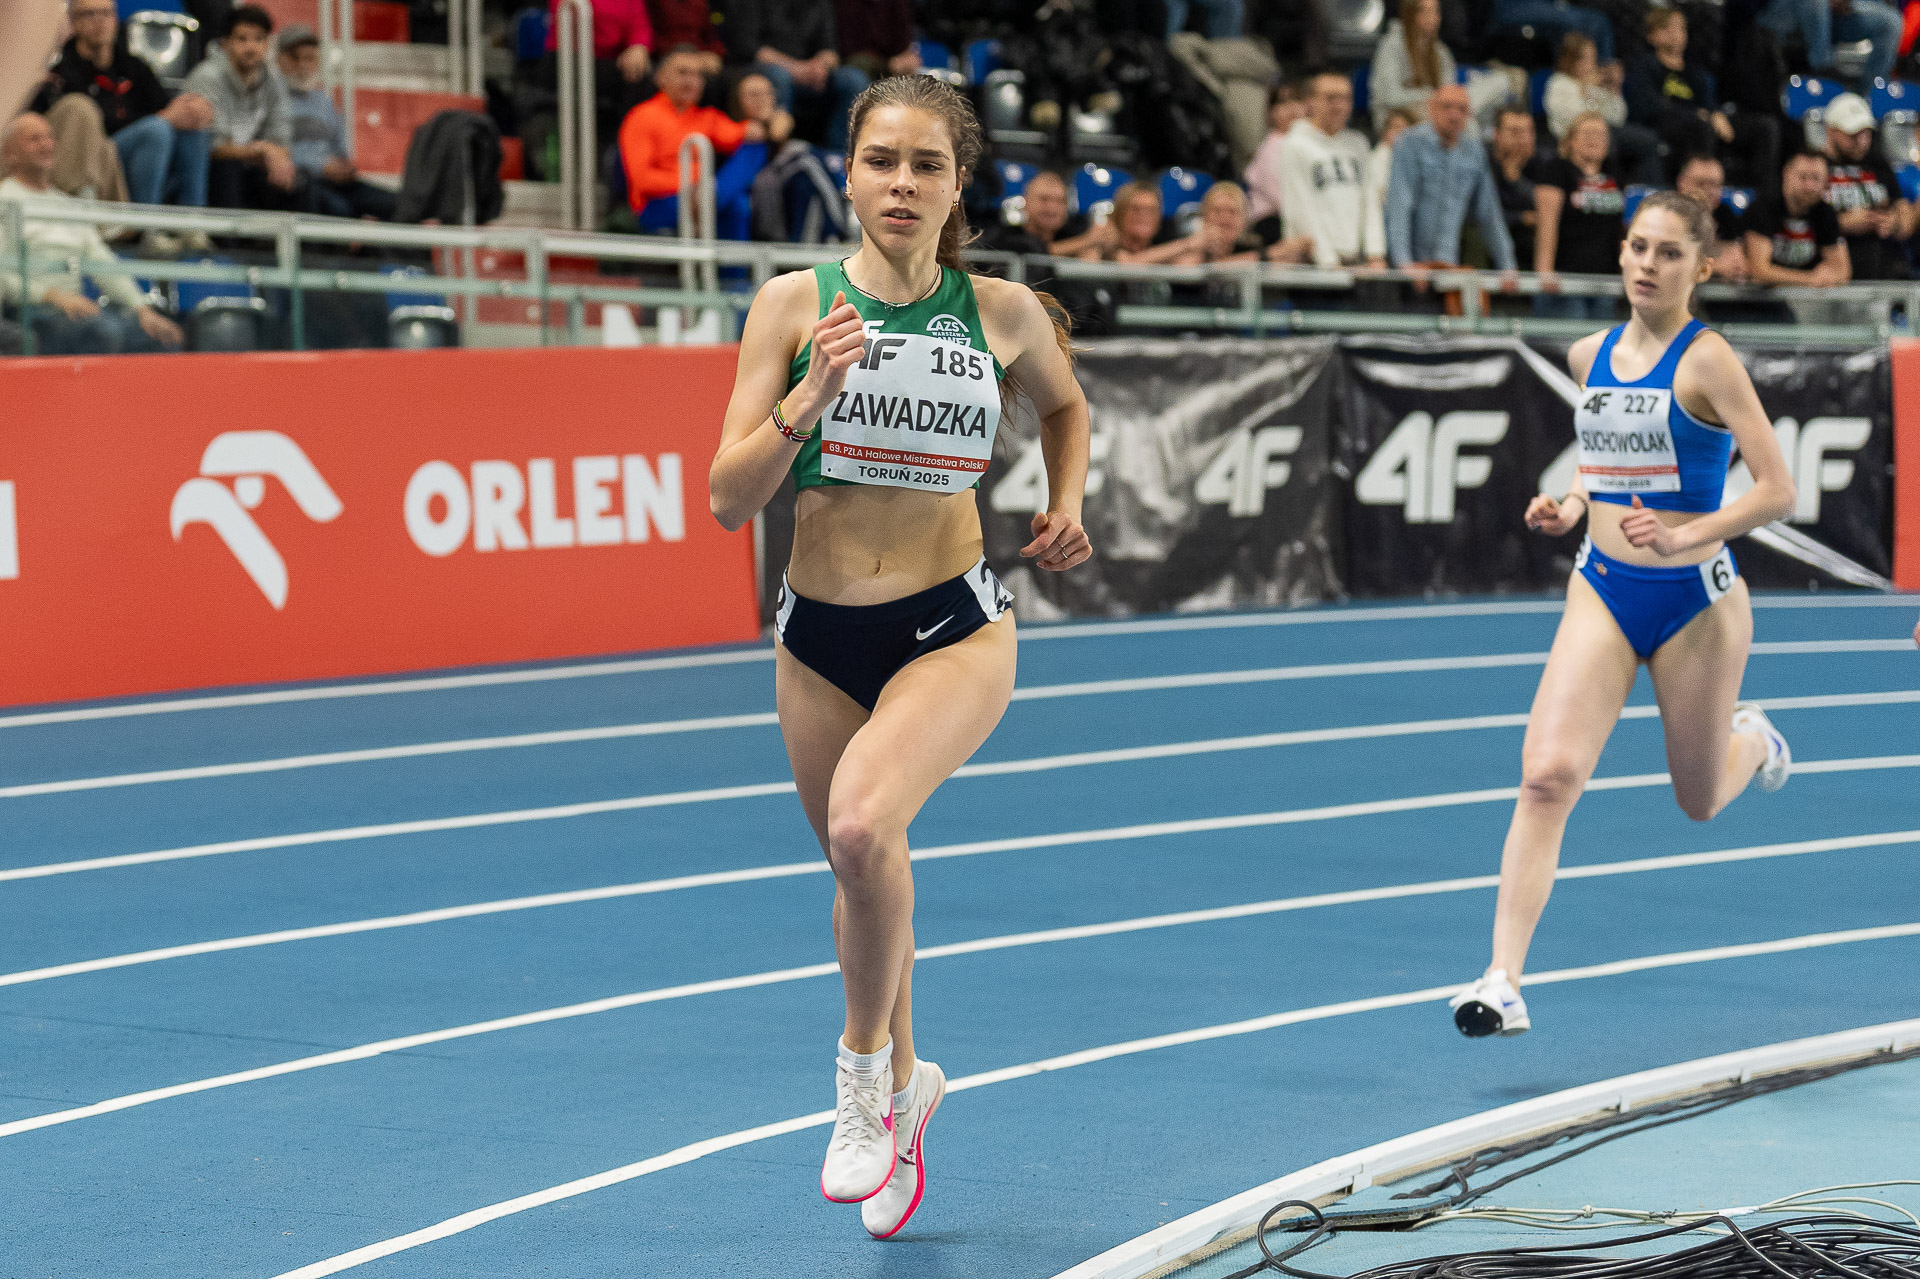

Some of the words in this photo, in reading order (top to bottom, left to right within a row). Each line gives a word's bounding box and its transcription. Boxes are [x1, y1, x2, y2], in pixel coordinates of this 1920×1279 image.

[936, 321, 960, 332] AZS
[930, 346, 984, 381] 185
[831, 391, 986, 438] ZAWADZKA
[1583, 393, 1612, 414] 4F
[1624, 394, 1659, 414] 227
[828, 443, 842, 454] 69.
[843, 446, 863, 457] PZLA
[865, 449, 901, 461] Halowe
[903, 451, 957, 467] Mistrzostwa
[959, 459, 985, 470] Polski
[1581, 430, 1670, 453] SUCHOWOLAK
[858, 466, 910, 482] TORUŃ
[913, 471, 949, 486] 2025
[1195, 425, 1303, 517] 4F
[1355, 409, 1510, 524] 4F
[404, 453, 685, 557] ORLEN
[1712, 559, 1730, 592] 6
